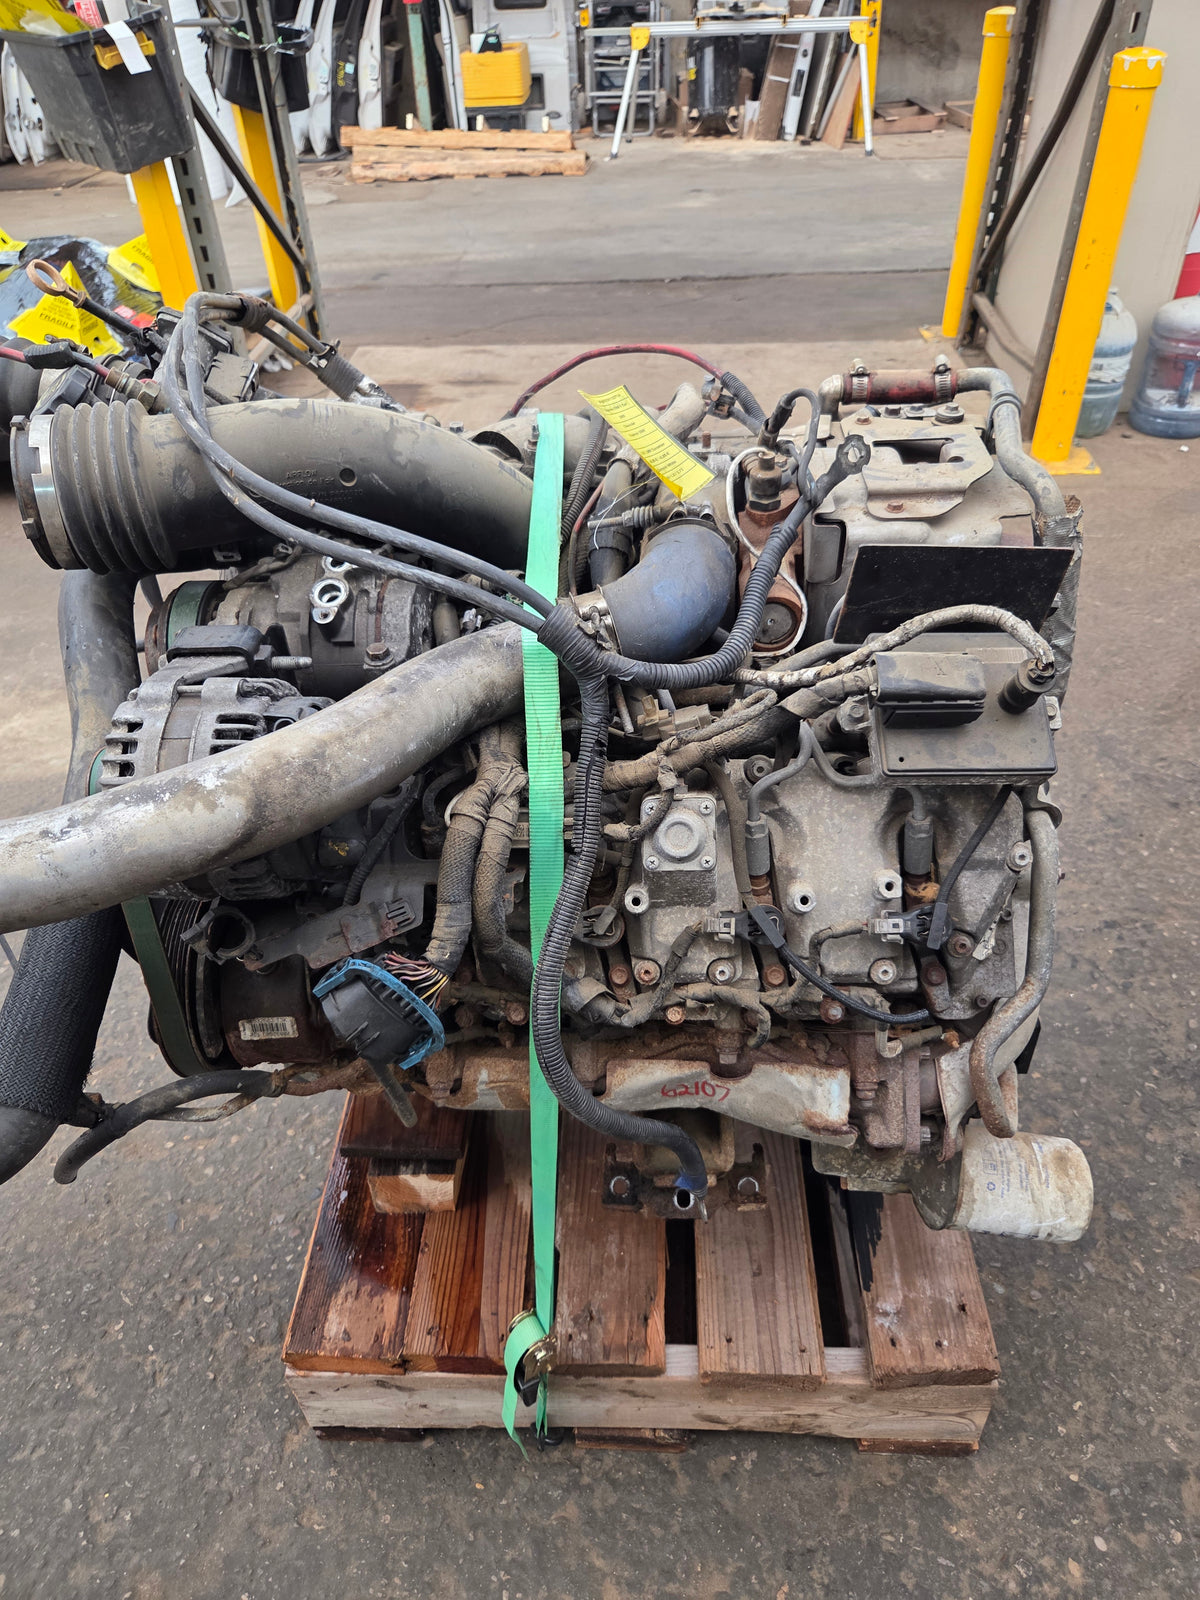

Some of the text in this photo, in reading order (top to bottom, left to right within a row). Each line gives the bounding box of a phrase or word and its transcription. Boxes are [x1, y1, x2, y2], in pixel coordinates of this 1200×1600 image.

[39, 312, 75, 330] FRAGILE
[286, 469, 318, 479] AIRFLOW
[661, 1081, 731, 1102] 62107
